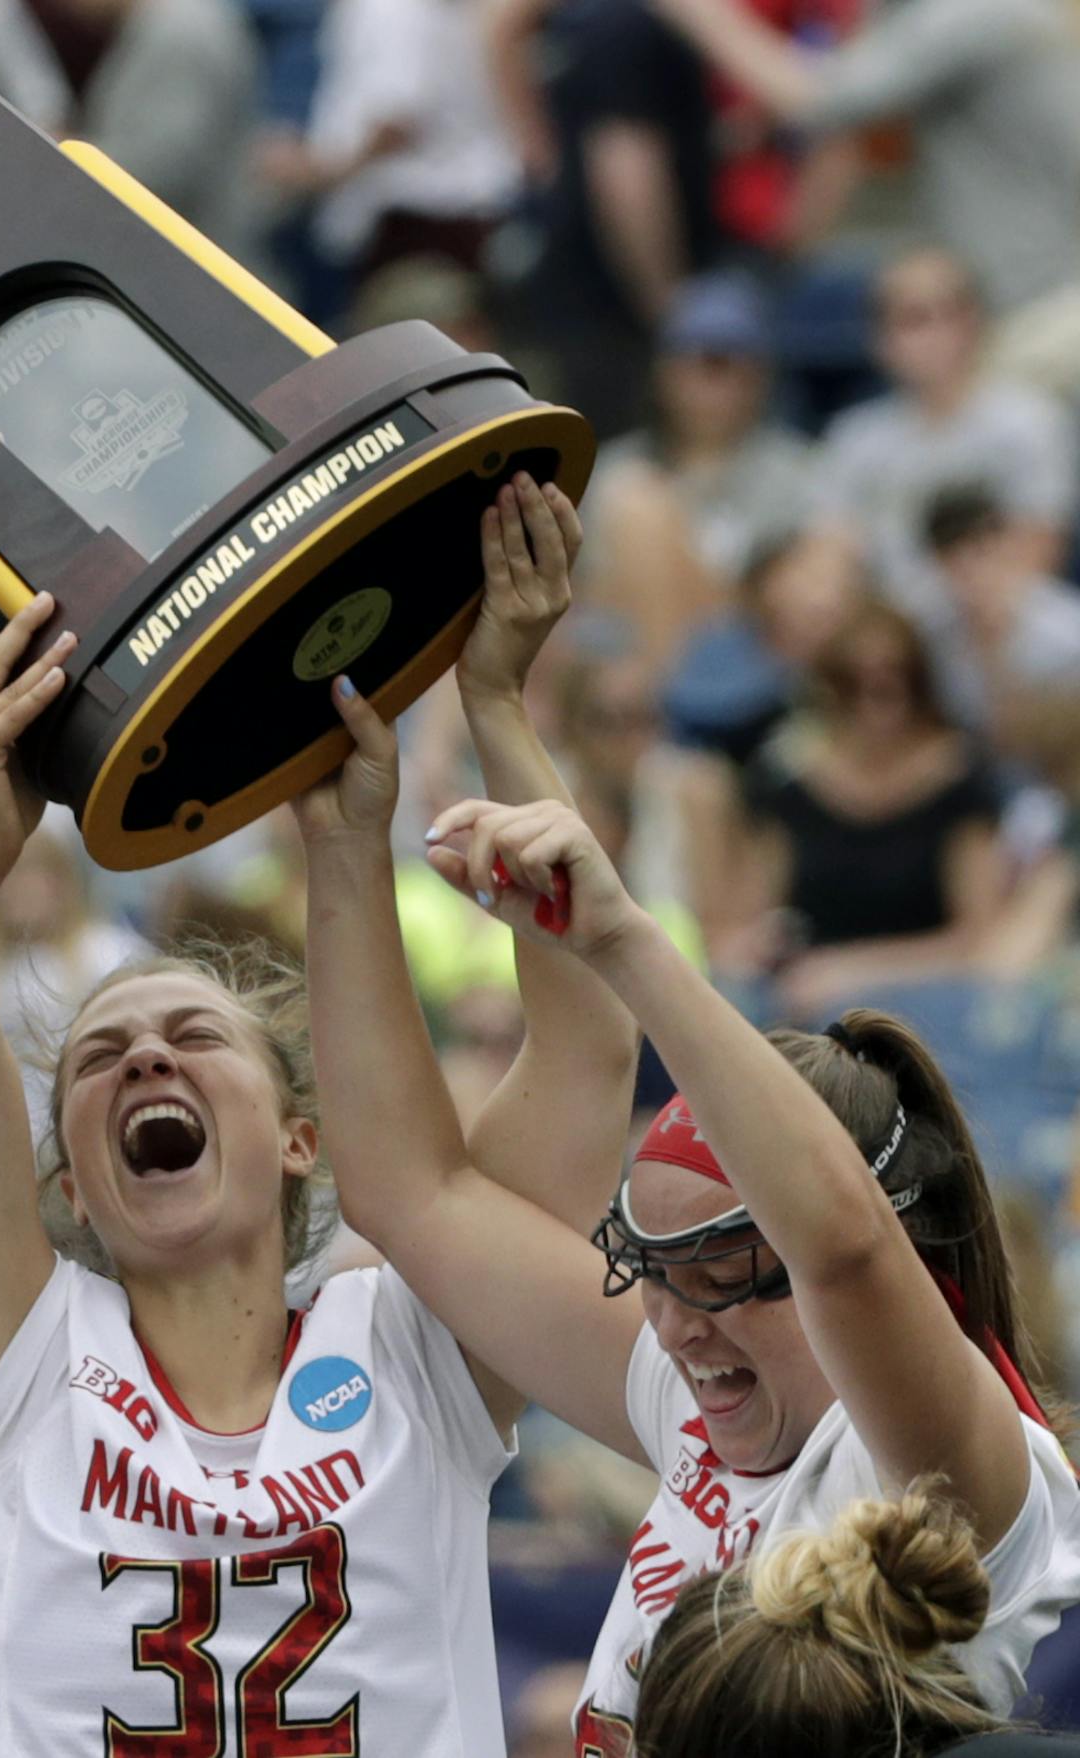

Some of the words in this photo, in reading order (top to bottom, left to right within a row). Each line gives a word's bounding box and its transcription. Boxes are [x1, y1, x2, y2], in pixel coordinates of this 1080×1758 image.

[73, 393, 178, 483] CHAMPIONSHIPS
[128, 535, 255, 666] NATIONAL
[250, 421, 405, 543] CHAMPION
[305, 1375, 370, 1422] NCAA
[99, 1521, 360, 1758] 32
